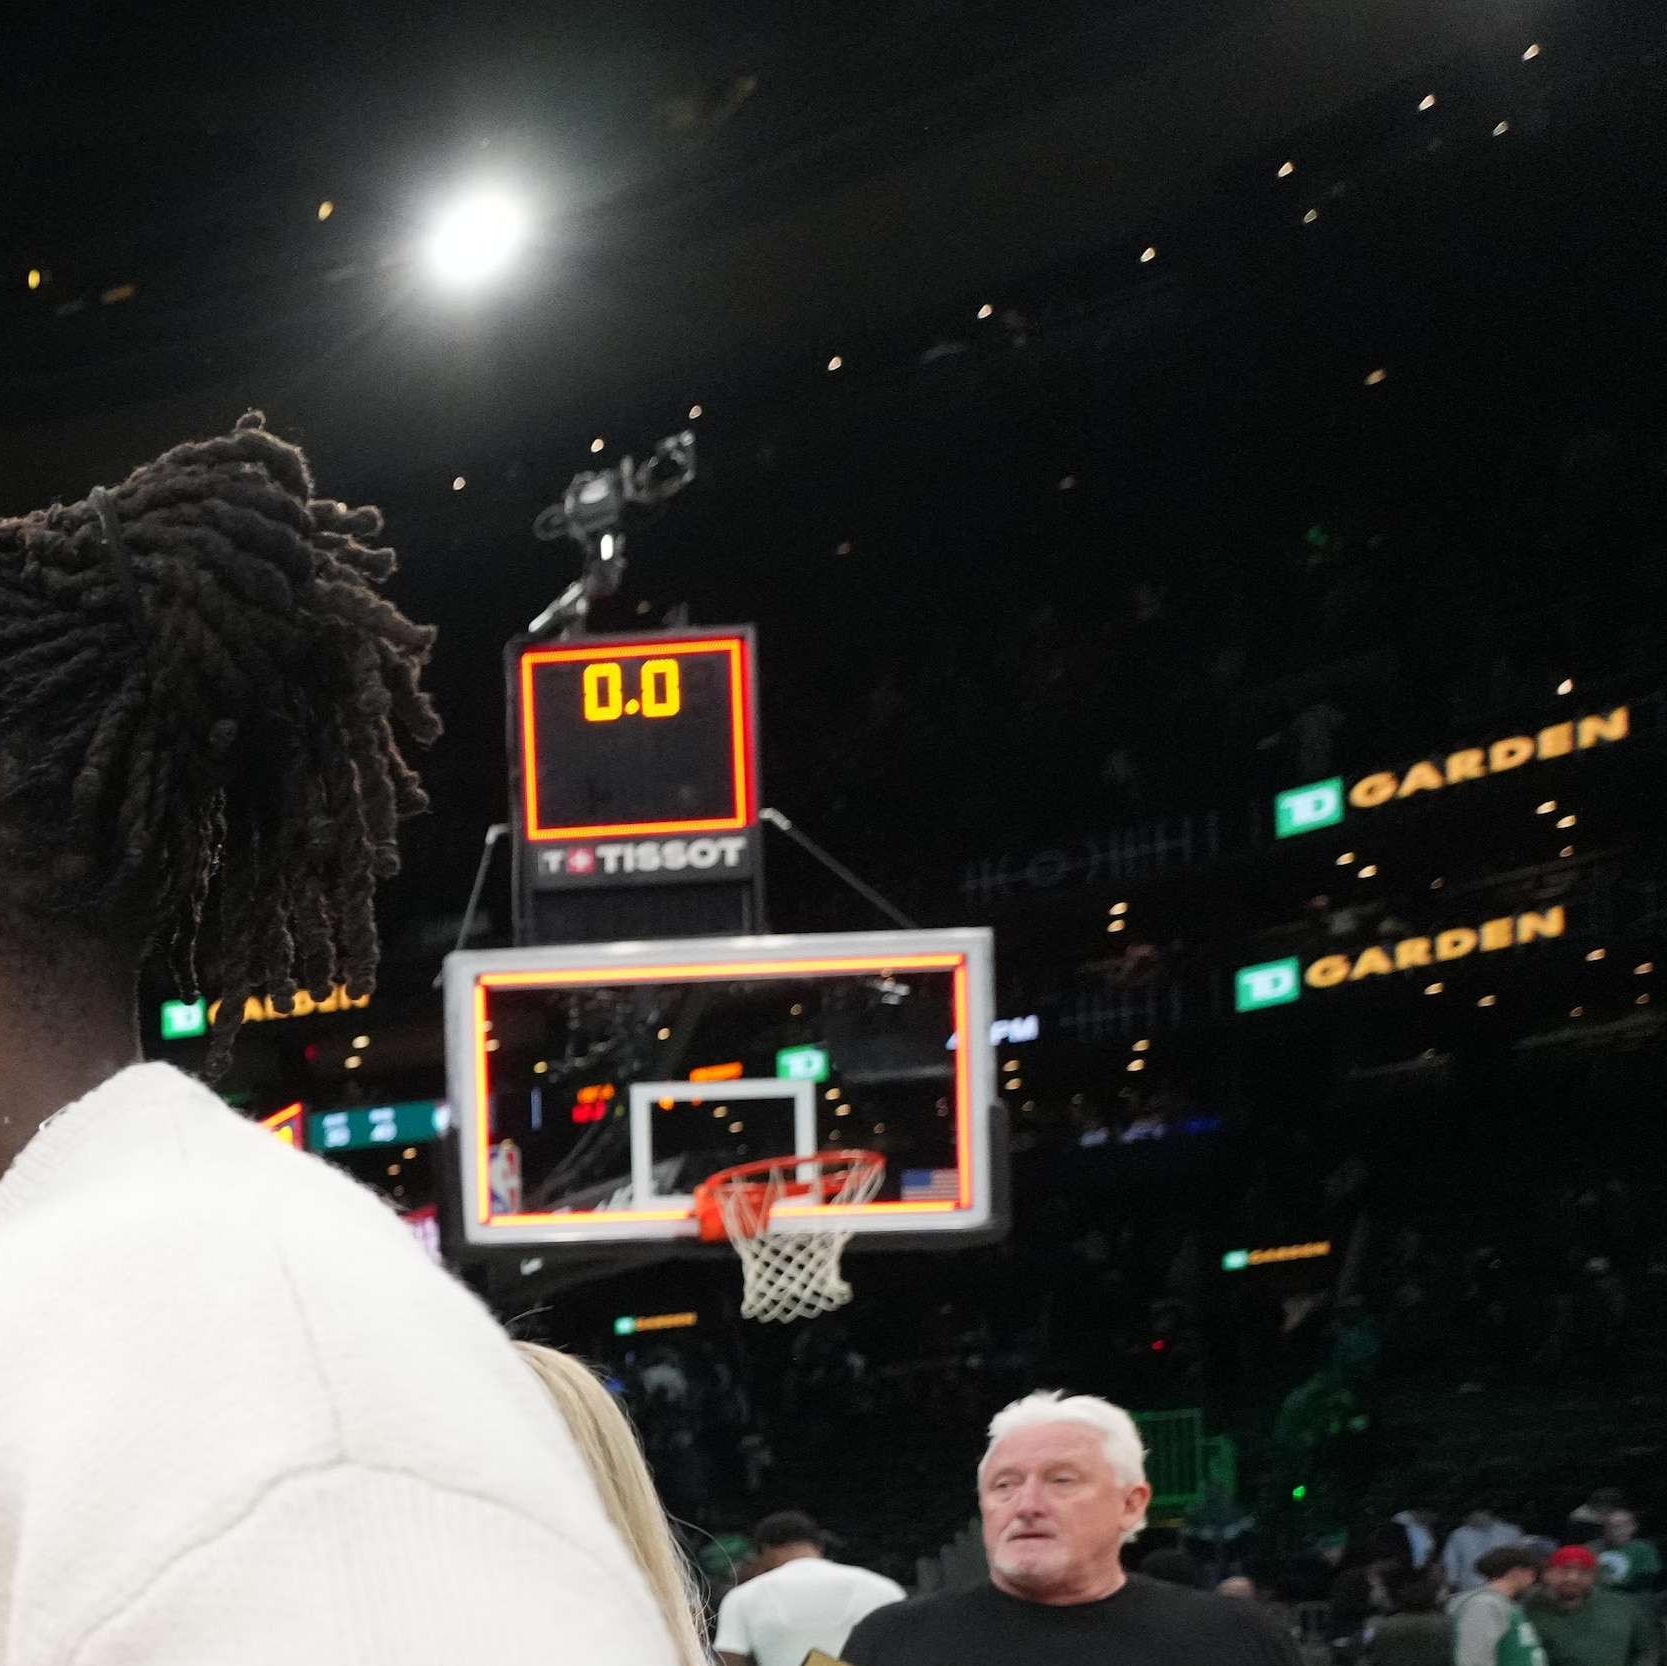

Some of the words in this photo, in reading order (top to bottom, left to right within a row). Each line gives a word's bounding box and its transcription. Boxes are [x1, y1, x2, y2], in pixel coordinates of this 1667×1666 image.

[583, 658, 681, 722] 0.0
[1284, 787, 1338, 825] TD
[1349, 706, 1630, 808] GARDEN
[595, 836, 747, 874] TISSOT
[1244, 966, 1295, 1001] TD
[1304, 905, 1565, 988] GARDEN
